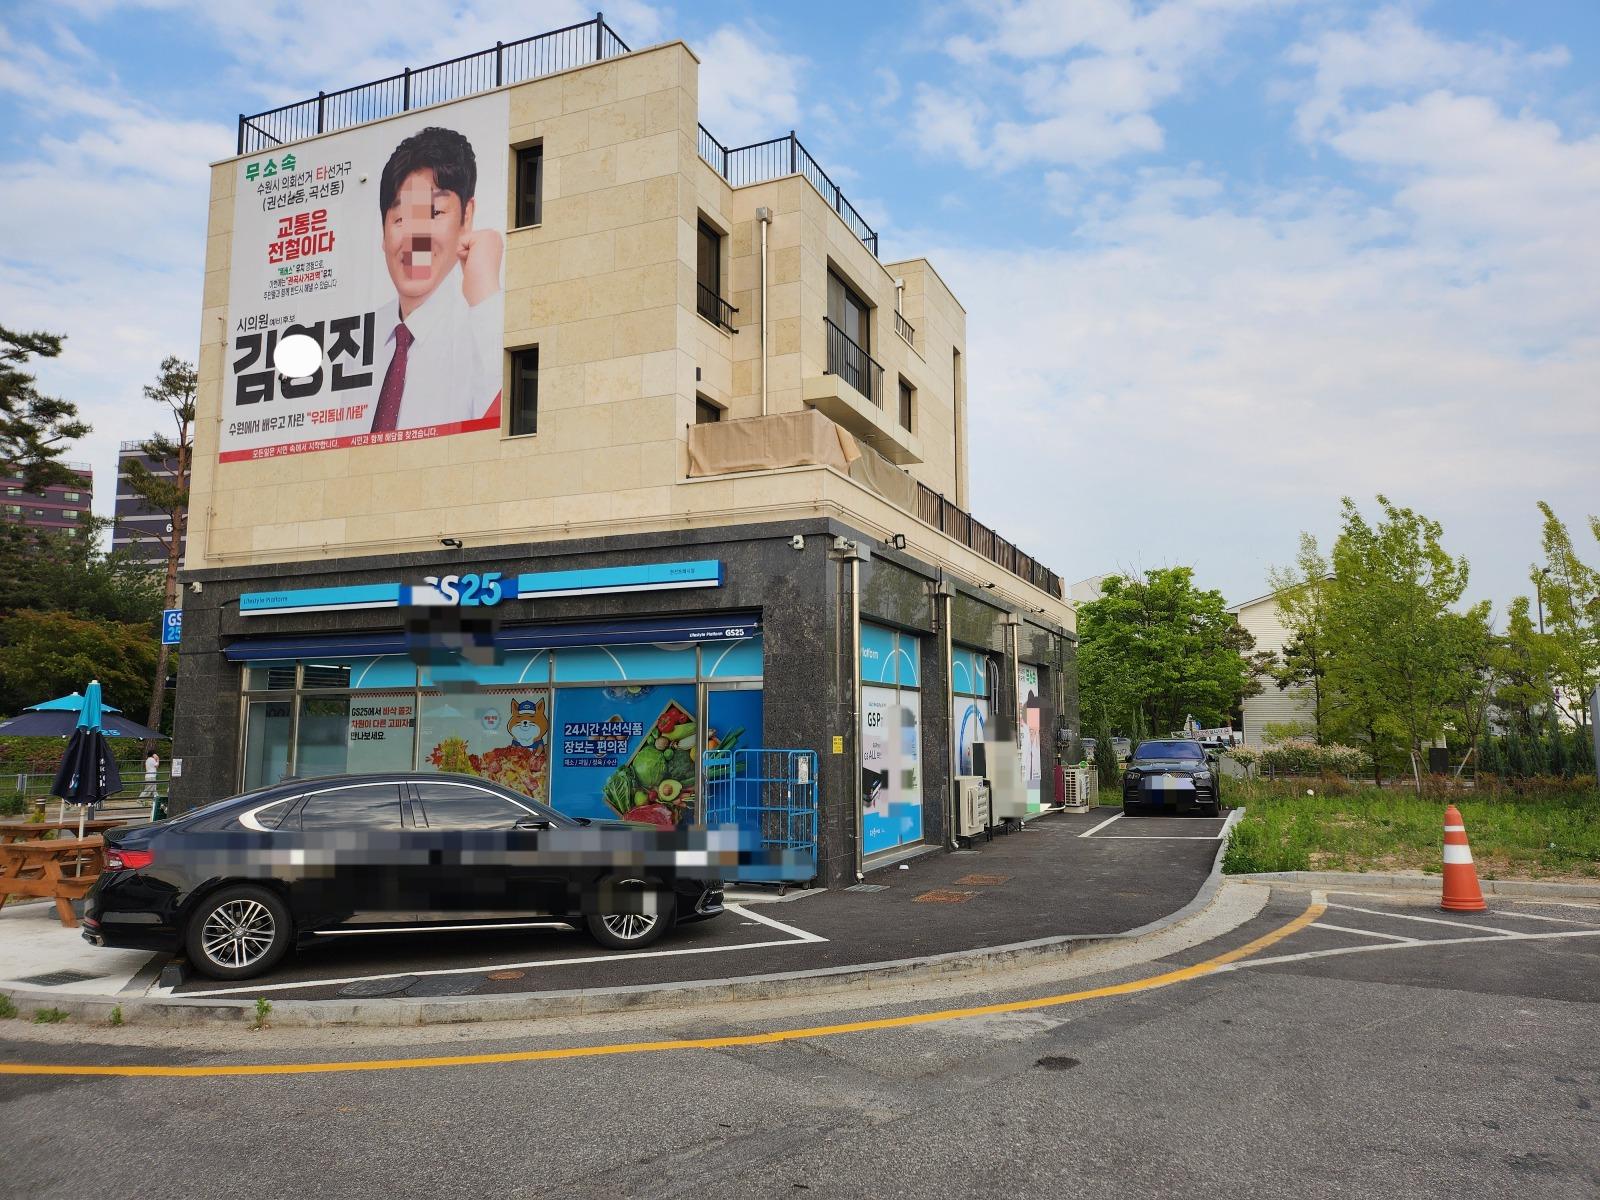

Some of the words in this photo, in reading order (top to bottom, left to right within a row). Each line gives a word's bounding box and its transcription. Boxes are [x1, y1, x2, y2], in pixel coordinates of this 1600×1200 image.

[246, 153, 296, 181] 무소속
[257, 177, 280, 195] 수원시
[282, 170, 313, 189] 의회선거
[316, 161, 352, 181] 타선거구
[309, 180, 344, 199] 곡선동)
[277, 209, 327, 239] 교통은
[268, 230, 335, 264] 전철이다
[237, 313, 269, 332] 시의원
[228, 419, 260, 436] 수원에서
[261, 415, 285, 431] 배우고
[287, 412, 305, 428] 자란
[423, 572, 501, 606] S25
[168, 613, 182, 626] GS
[725, 629, 745, 637] GS25
[351, 707, 382, 717] GS25에서
[373, 719, 386, 728] 다른
[565, 722, 600, 736] 24시간
[601, 722, 643, 736] 신선식품
[351, 731, 386, 741] 만나보세요.
[564, 741, 595, 754] 장보는
[596, 740, 627, 754] 편의점
